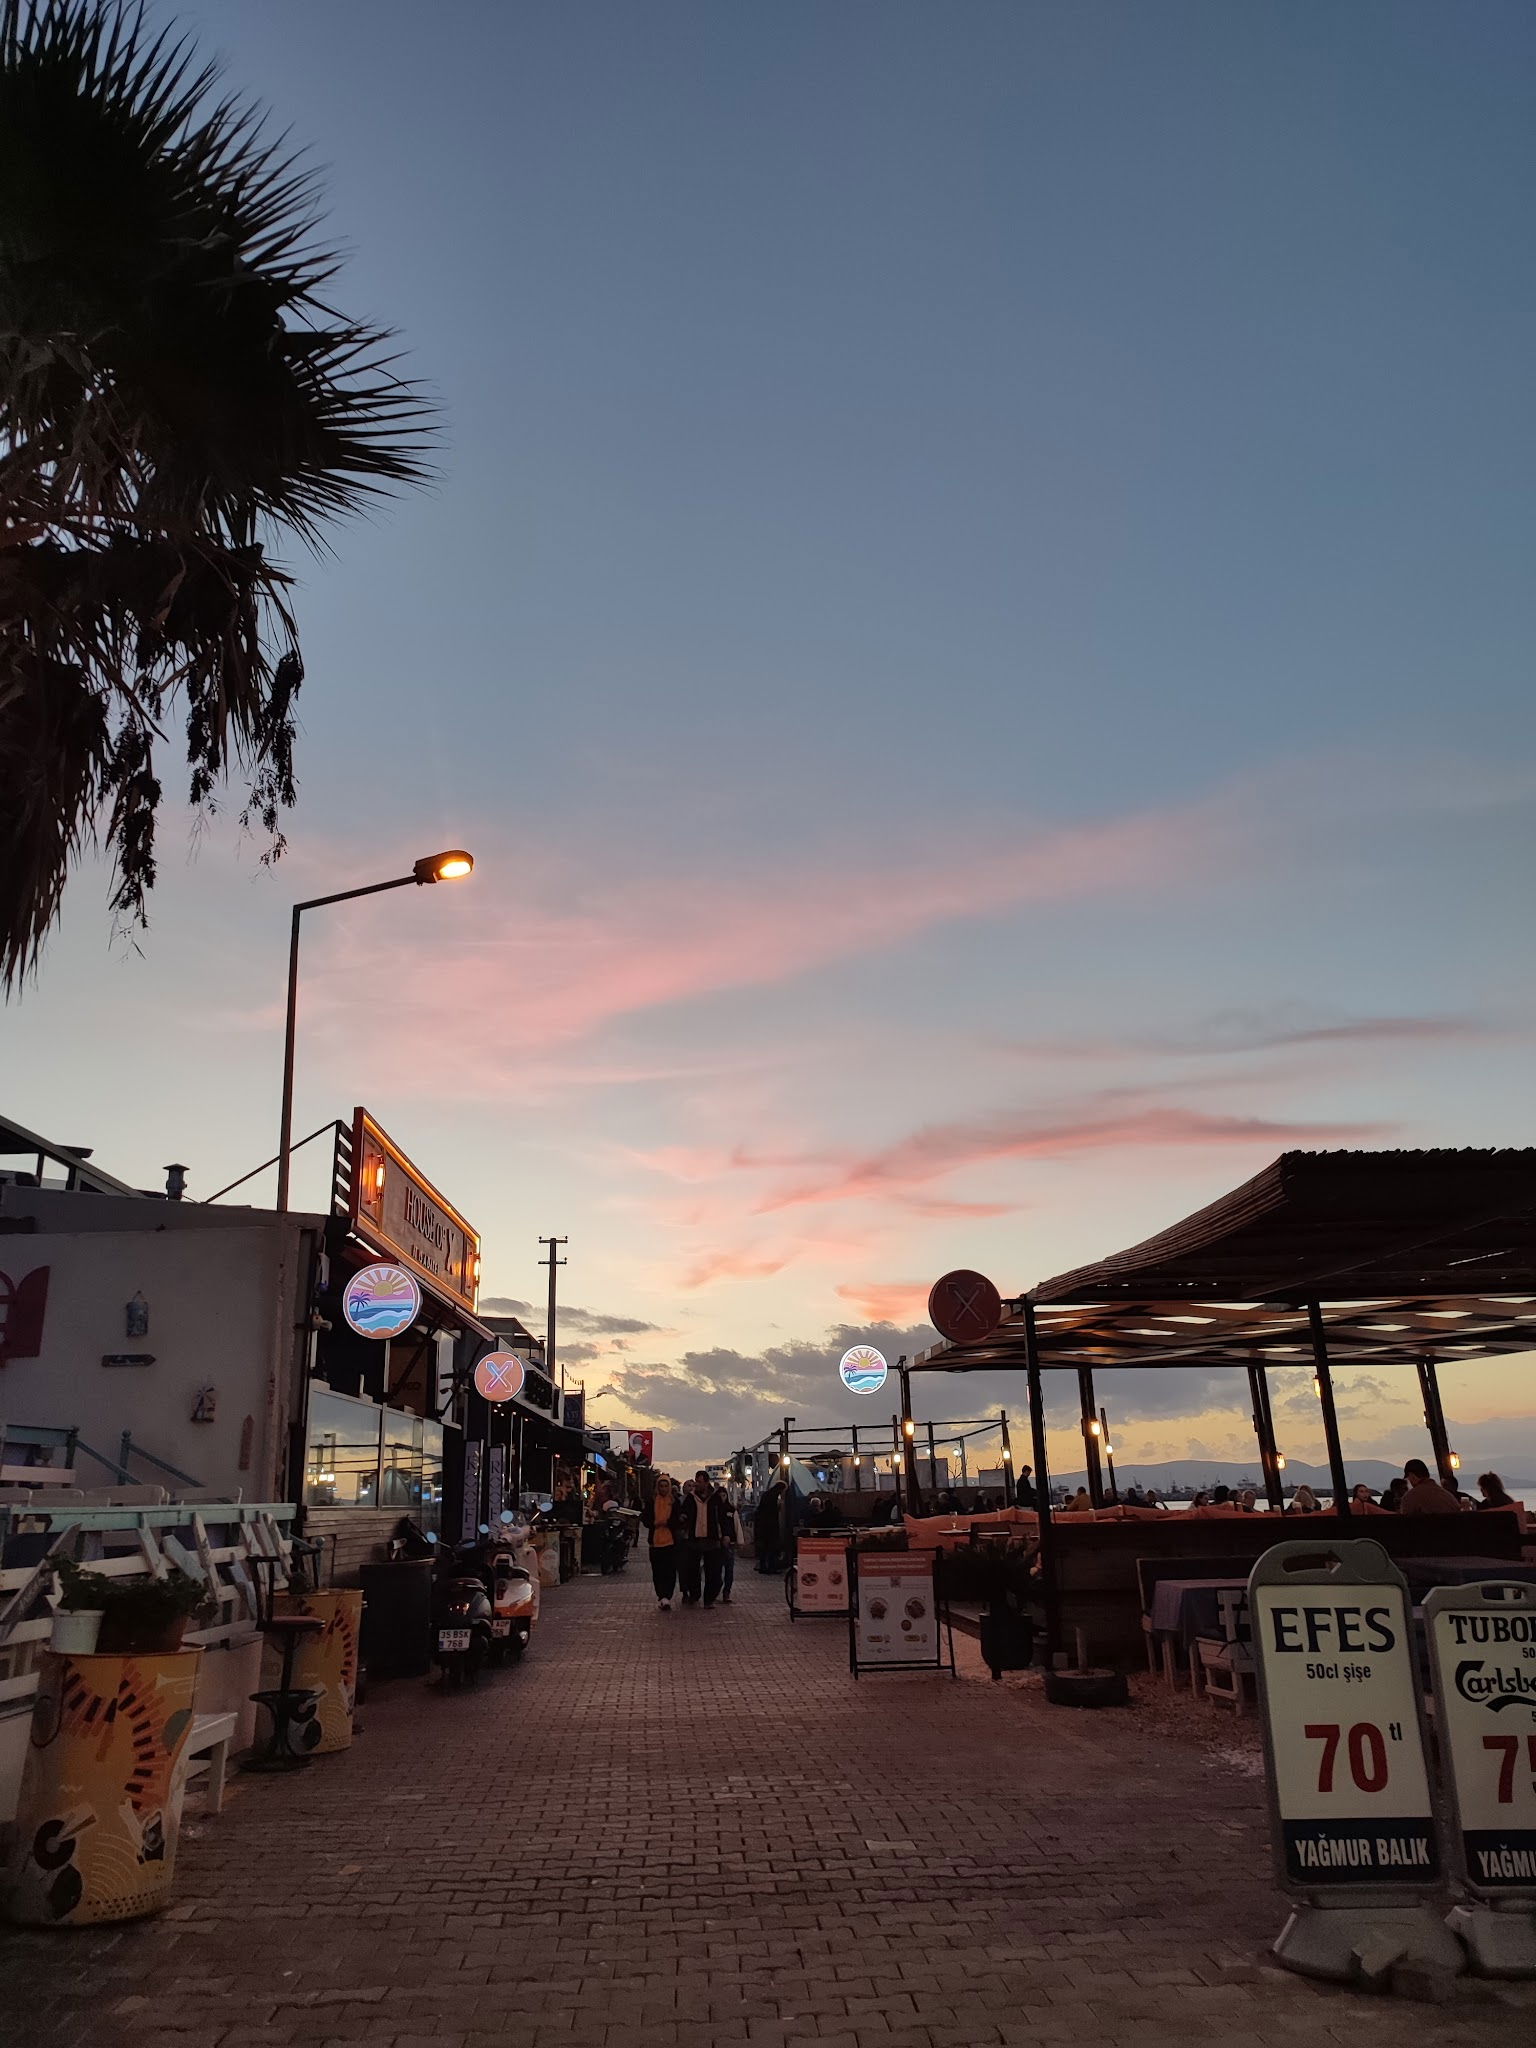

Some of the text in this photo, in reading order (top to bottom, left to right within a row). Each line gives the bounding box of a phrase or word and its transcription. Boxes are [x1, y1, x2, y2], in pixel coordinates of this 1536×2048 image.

[440, 1631, 451, 1639] 35
[1270, 1606, 1395, 1653] EFES
[1307, 1663, 1372, 1683] 50cl şişe
[1304, 1722, 1402, 1793] 70 tl
[1482, 1735, 1536, 1803] 7
[1294, 1833, 1431, 1868] YAĞMUR BALIK
